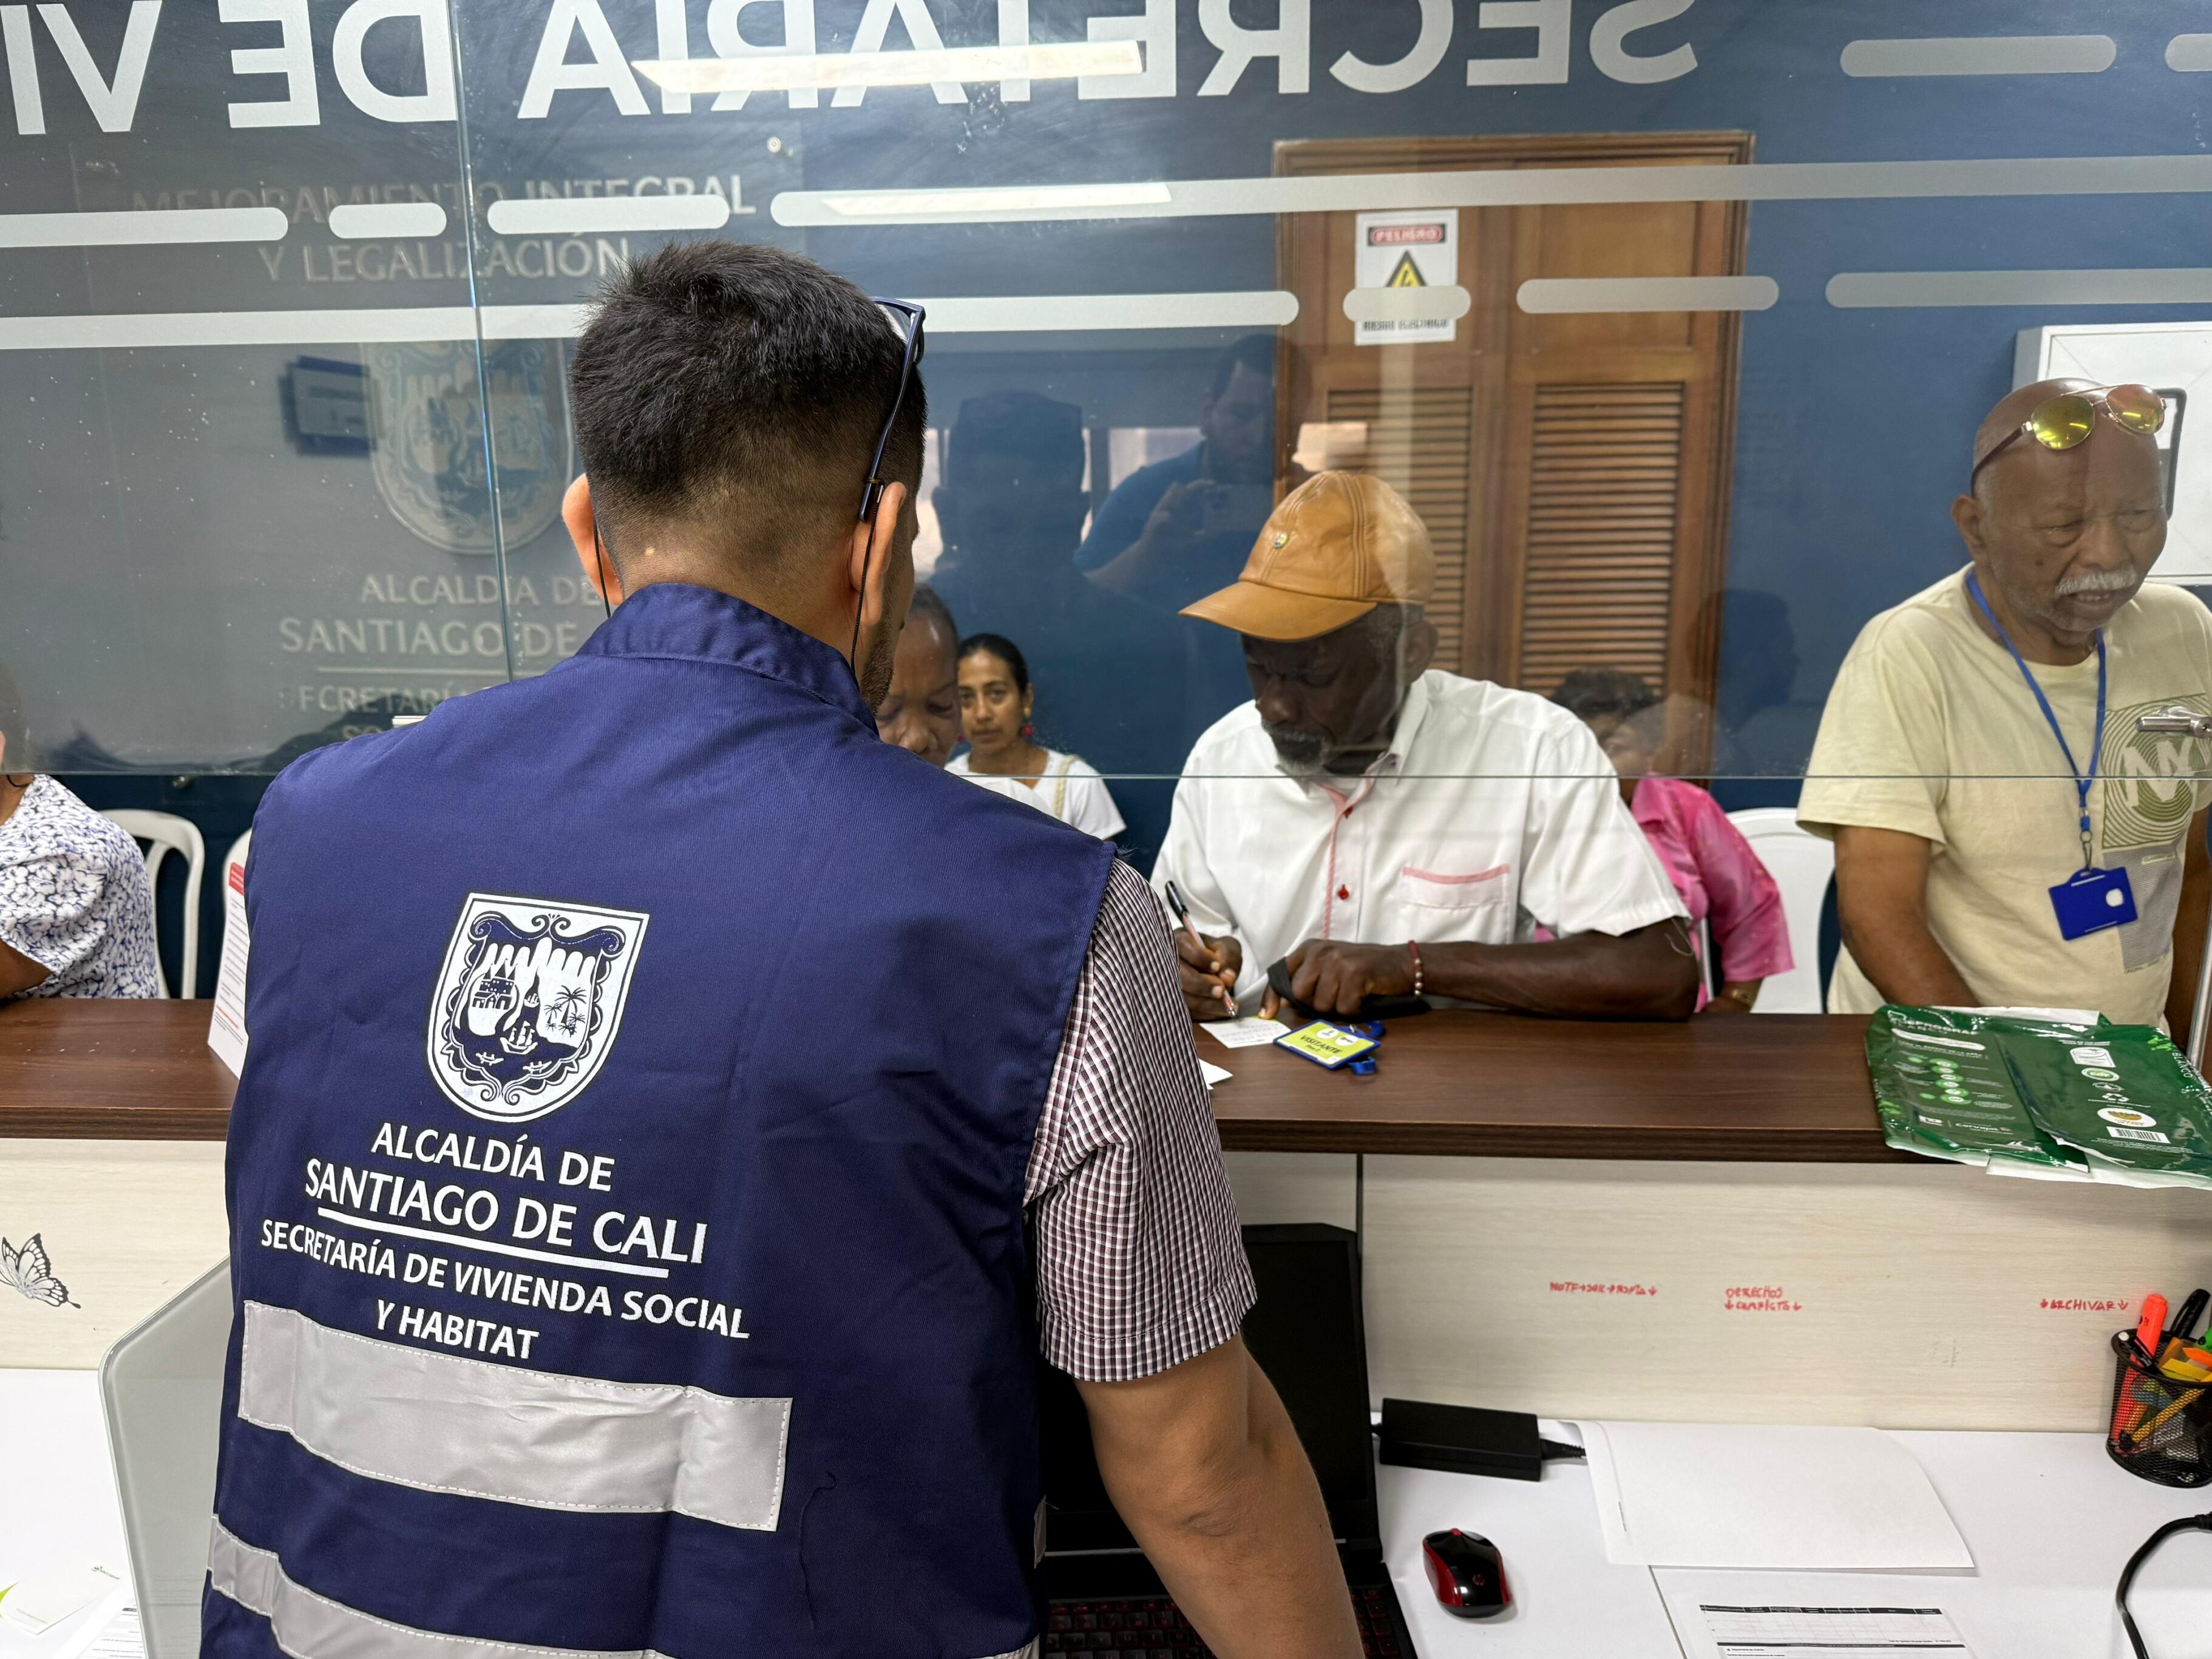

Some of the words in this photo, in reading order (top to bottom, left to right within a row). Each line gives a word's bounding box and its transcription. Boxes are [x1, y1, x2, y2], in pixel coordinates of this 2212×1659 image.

[257, 245, 284, 282] Y
[279, 618, 504, 656] SANTIAGO
[524, 622, 578, 656] DE
[371, 1122, 545, 1181] ALCALDÍA
[559, 1151, 615, 1192] DE
[305, 1158, 498, 1231] SANTIAGO
[512, 1197, 577, 1246] DE
[592, 1212, 707, 1263] CALI
[261, 1219, 395, 1278] SECRETARÍA
[403, 1258, 447, 1286] DE
[455, 1262, 612, 1315] VIVIENDA
[621, 1291, 750, 1339] SOCIAL
[2050, 1299, 2115, 1311] ARCHIVAR
[376, 1299, 396, 1330] Y
[399, 1307, 540, 1359] HABITAT
